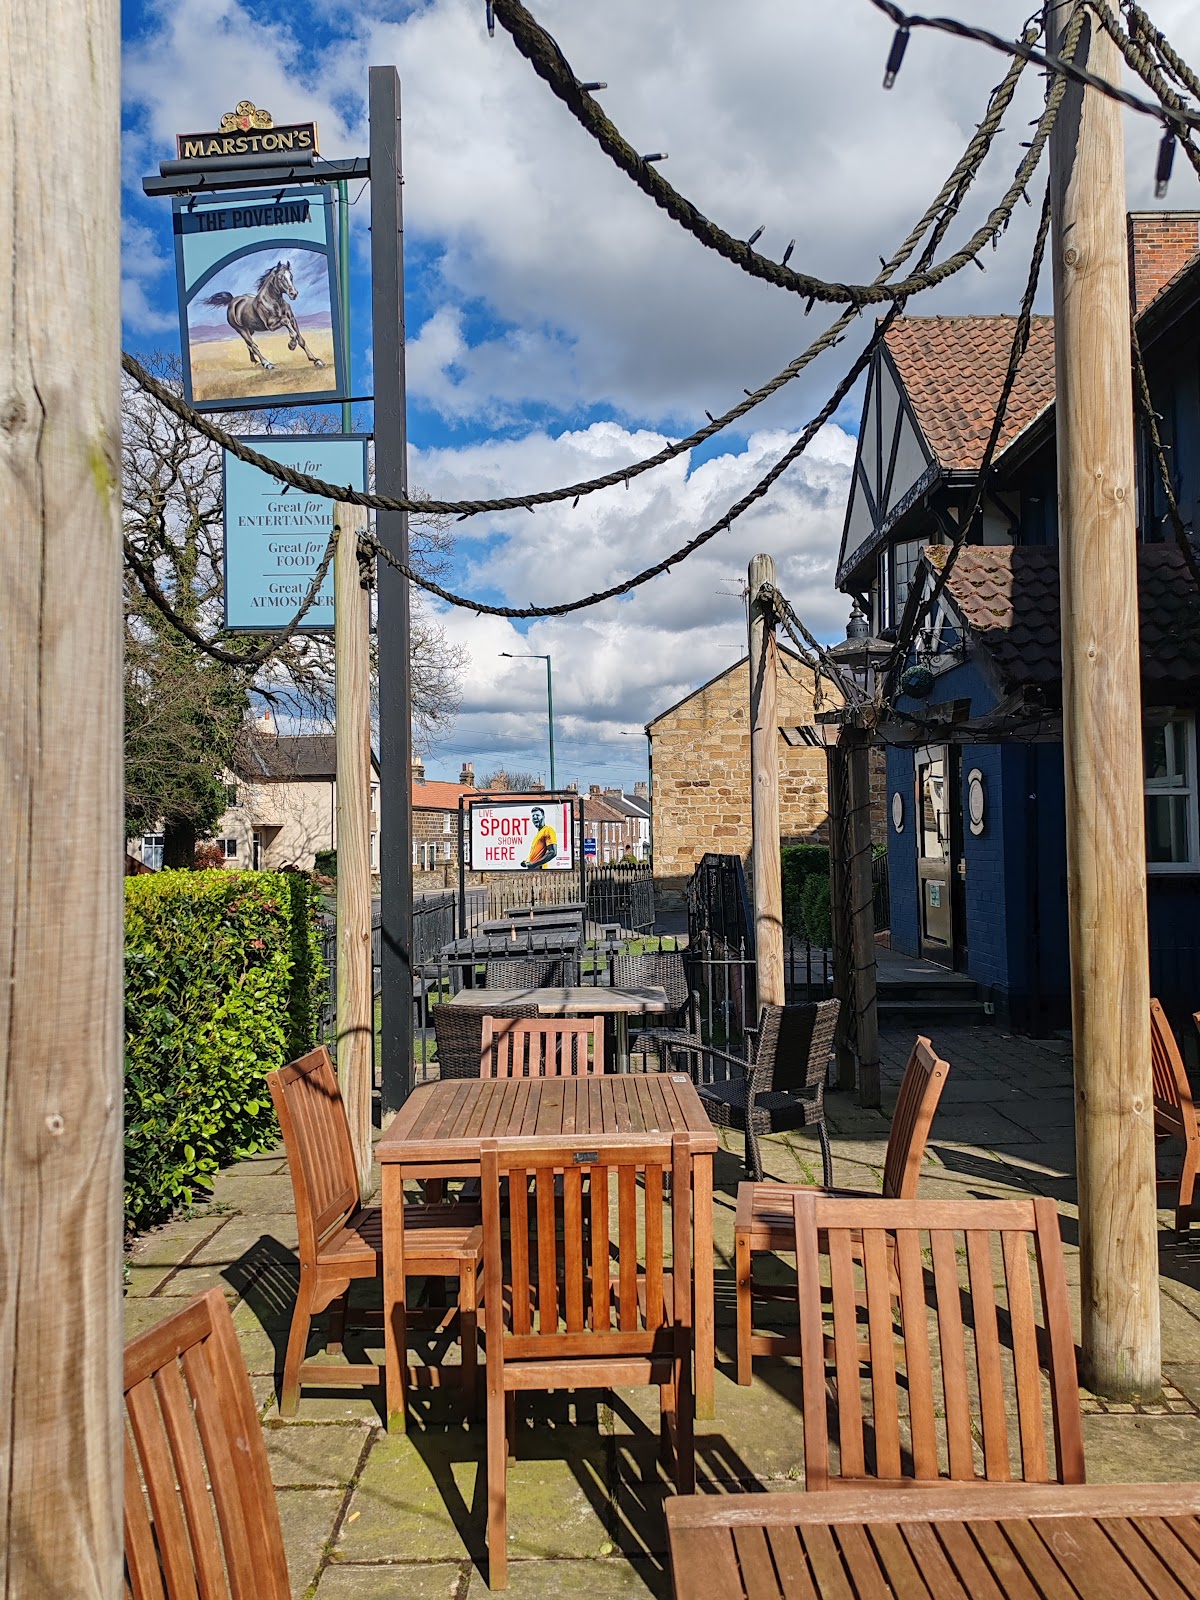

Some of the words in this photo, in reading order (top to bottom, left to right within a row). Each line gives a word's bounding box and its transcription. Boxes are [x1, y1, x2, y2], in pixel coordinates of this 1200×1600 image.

[184, 131, 311, 157] MARSTON'S
[196, 211, 226, 232] THE
[232, 205, 312, 229] POVERINA
[303, 460, 322, 474] for
[267, 501, 301, 513] Great
[303, 501, 323, 514] for
[238, 515, 334, 527] ENTERTAINME
[268, 542, 302, 554] Great
[304, 541, 324, 555] for
[276, 555, 316, 567] FOOD
[268, 583, 303, 594] Great
[478, 809, 494, 818] LIVE
[480, 818, 530, 836] SPORT
[497, 837, 523, 846] SHOWN
[485, 847, 515, 861] HERE
